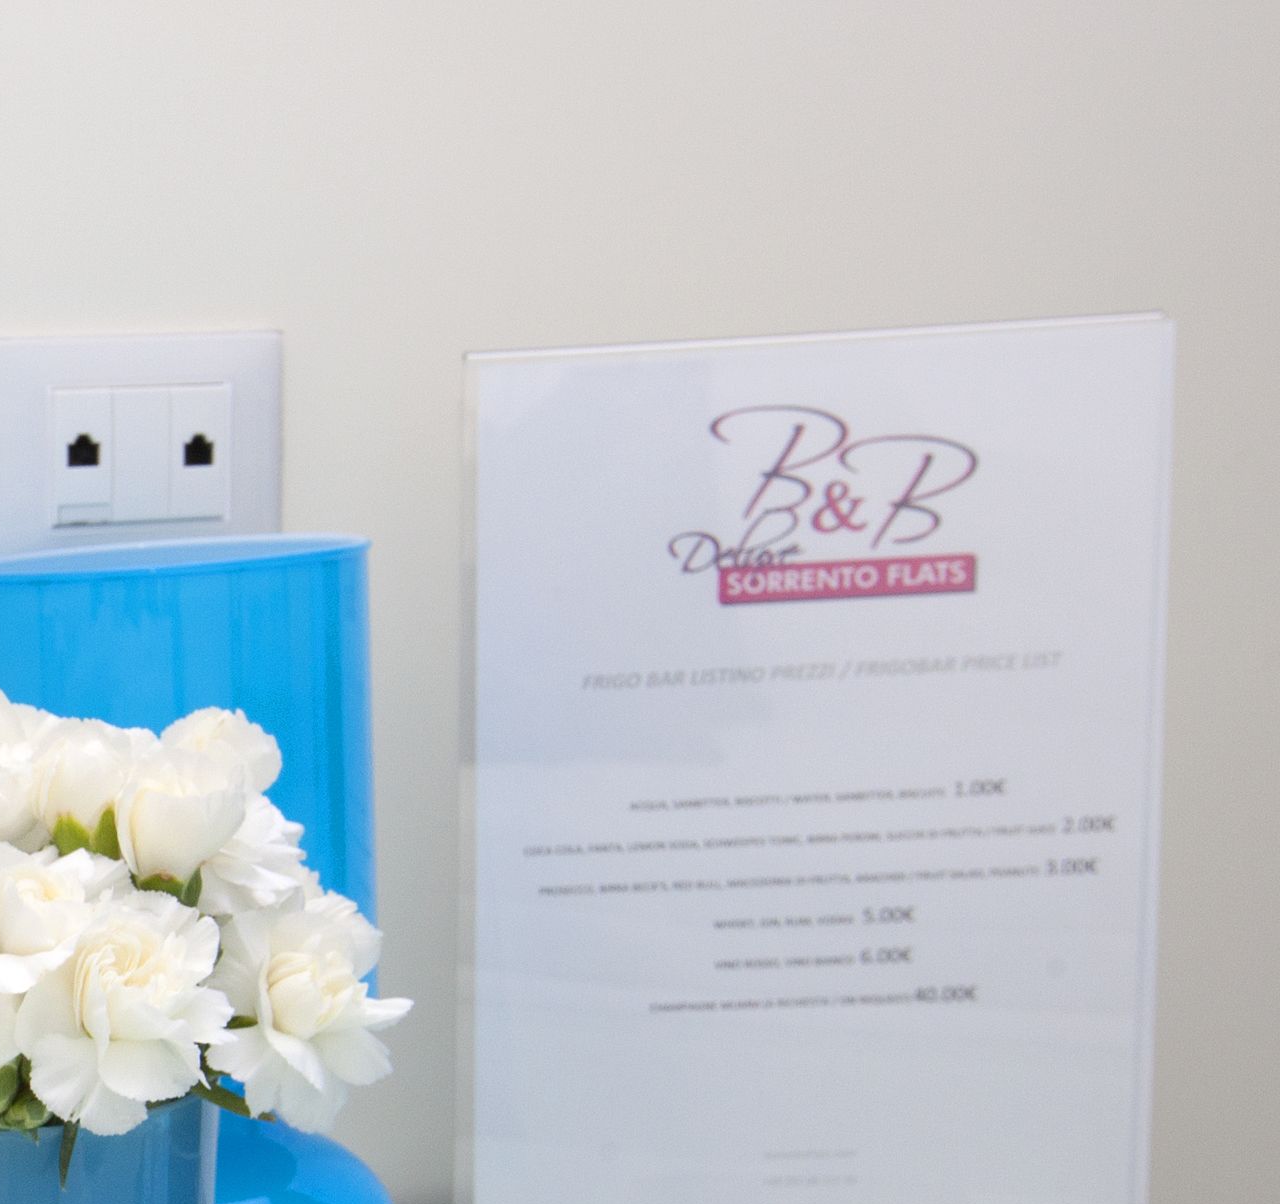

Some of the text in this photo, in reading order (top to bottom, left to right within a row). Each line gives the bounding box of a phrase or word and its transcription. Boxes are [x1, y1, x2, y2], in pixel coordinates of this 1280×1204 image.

[709, 403, 980, 550] B & B
[726, 560, 969, 597] SORRENTO FLATS
[582, 672, 640, 691] FRIGO
[645, 670, 686, 689] BAR
[689, 666, 765, 687] LISTINO
[770, 661, 836, 681] PREZZI
[960, 651, 1017, 672] PRICE
[1022, 648, 1064, 670] LIST
[954, 777, 1008, 798] 1.00€
[1061, 813, 1118, 835] 2.00€
